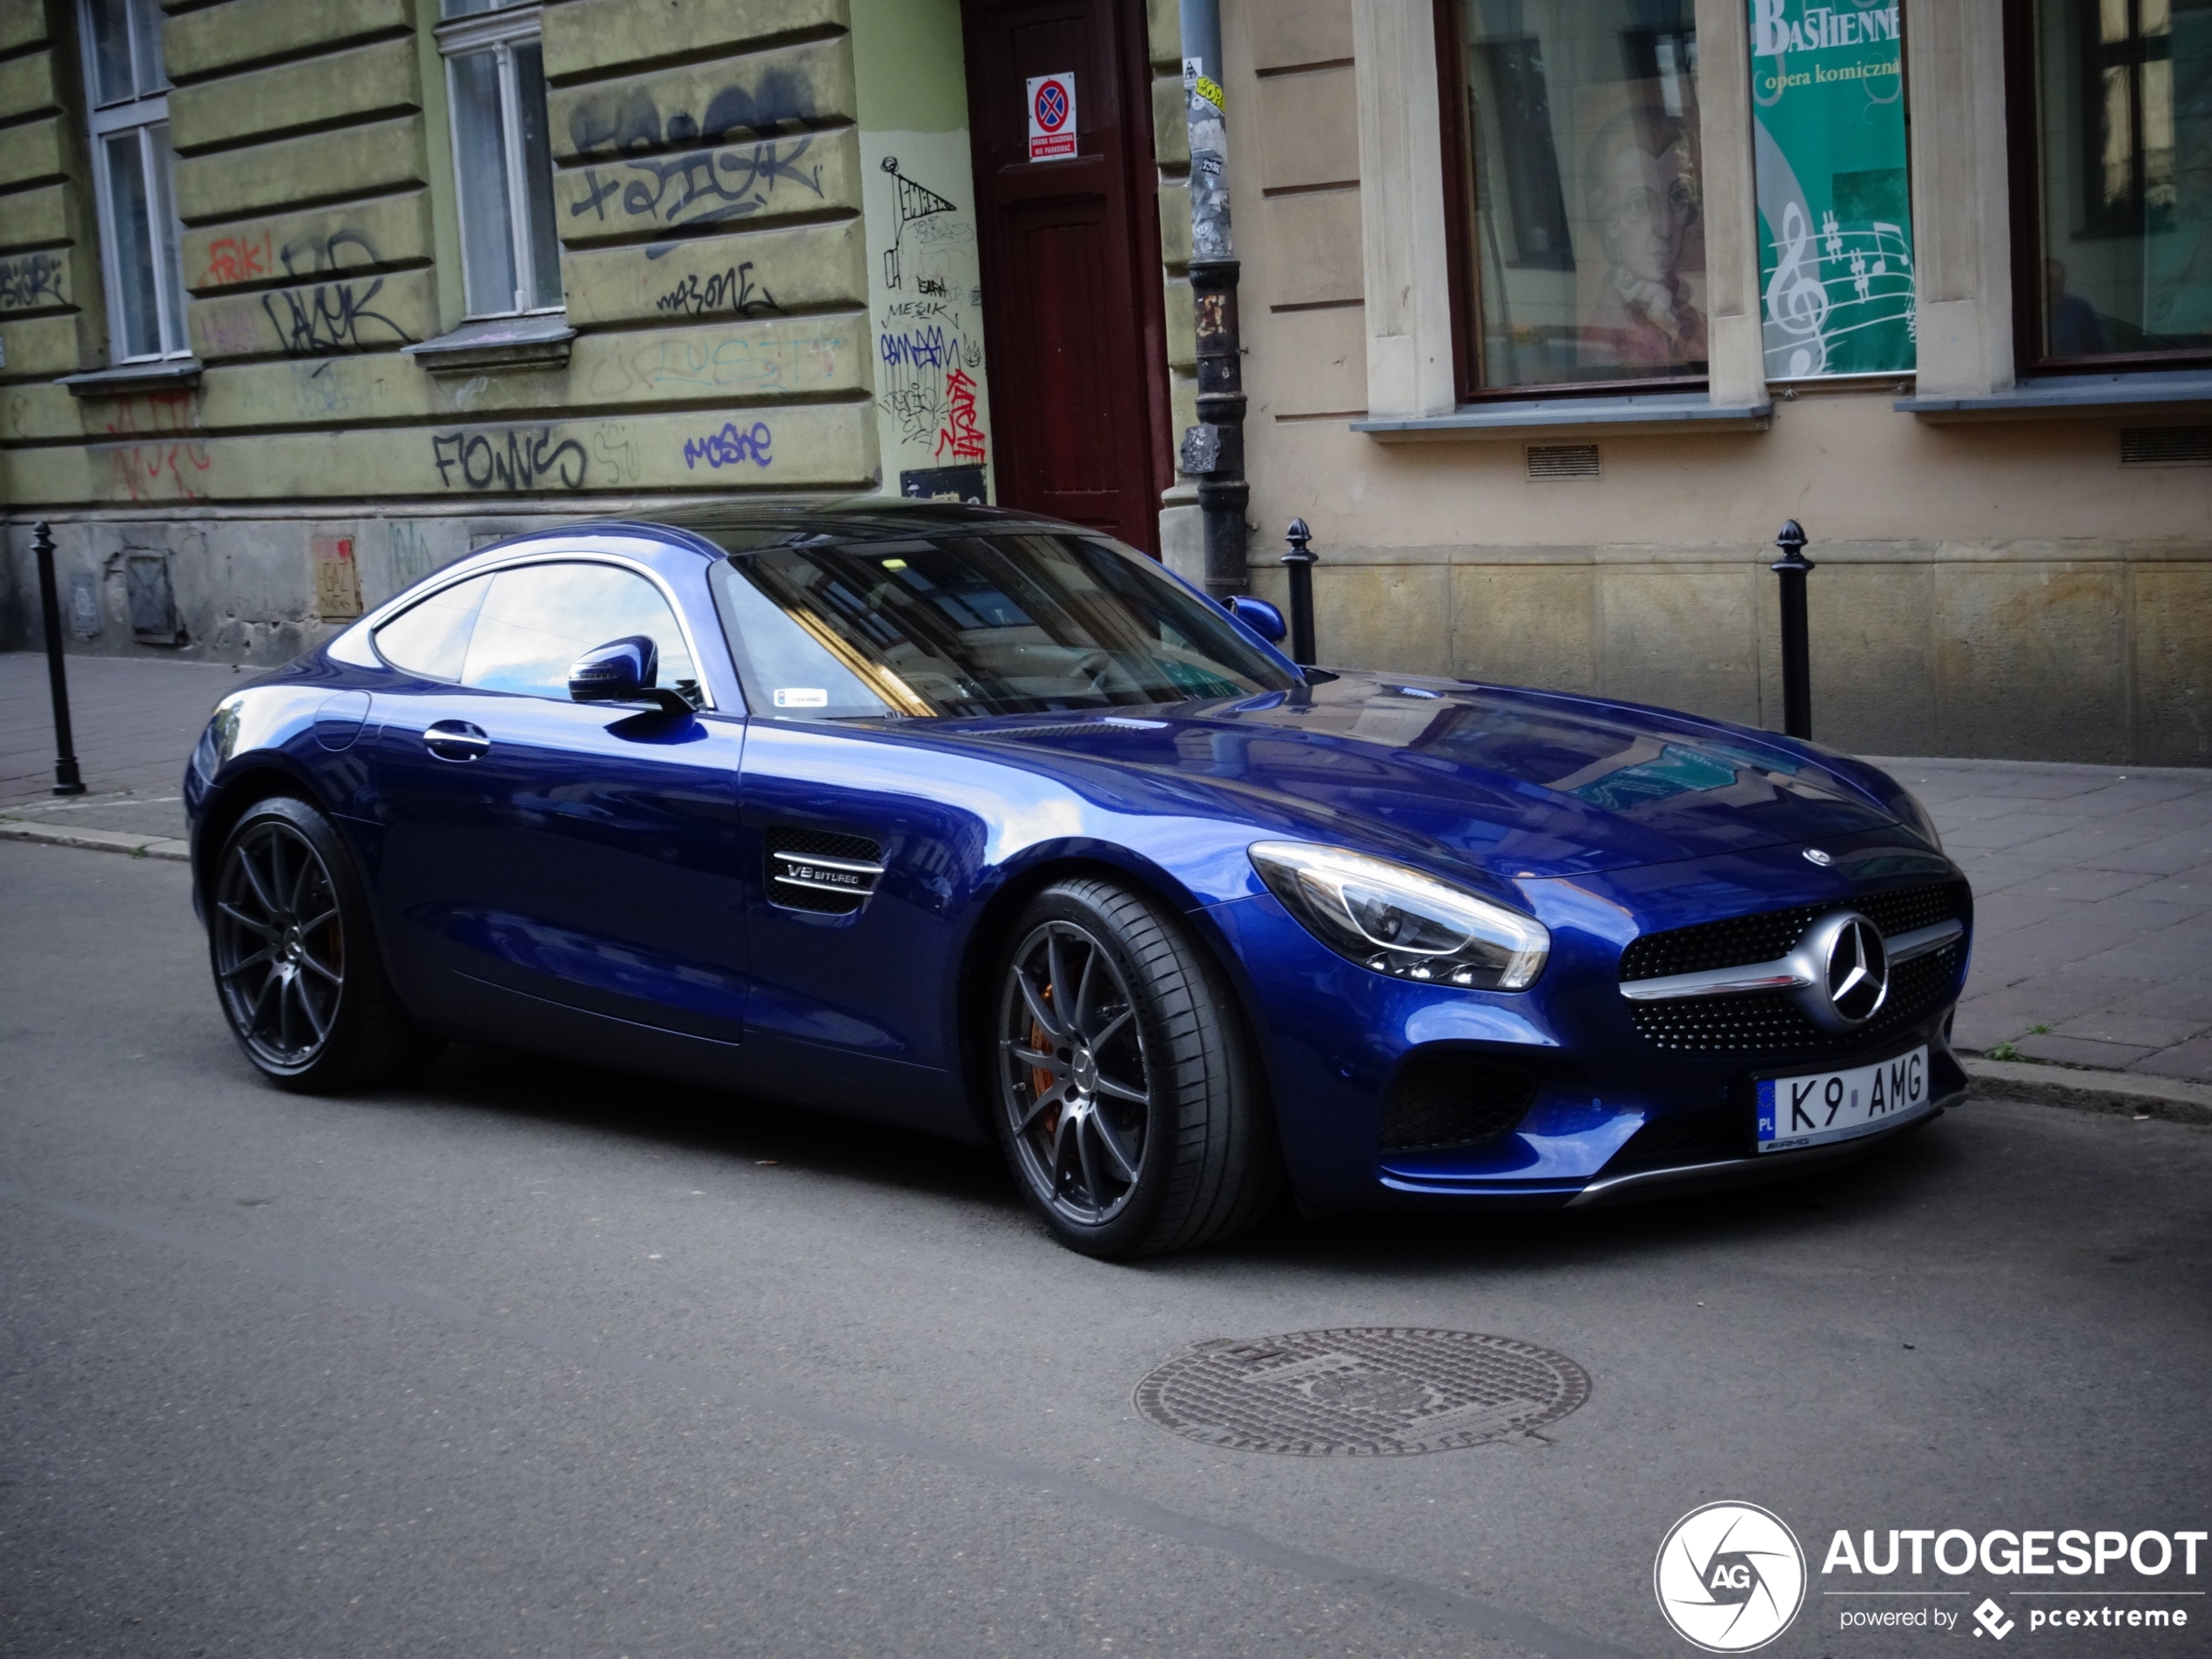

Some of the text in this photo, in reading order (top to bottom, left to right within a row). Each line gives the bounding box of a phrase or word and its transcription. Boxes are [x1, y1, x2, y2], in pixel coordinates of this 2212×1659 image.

[1765, 59, 1900, 94] opera komiczna
[787, 864, 813, 879] V8
[1791, 1053, 1921, 1132] K9 AMG
[1758, 1117, 1773, 1131] PL
[1780, 1137, 1810, 1147] AMG
